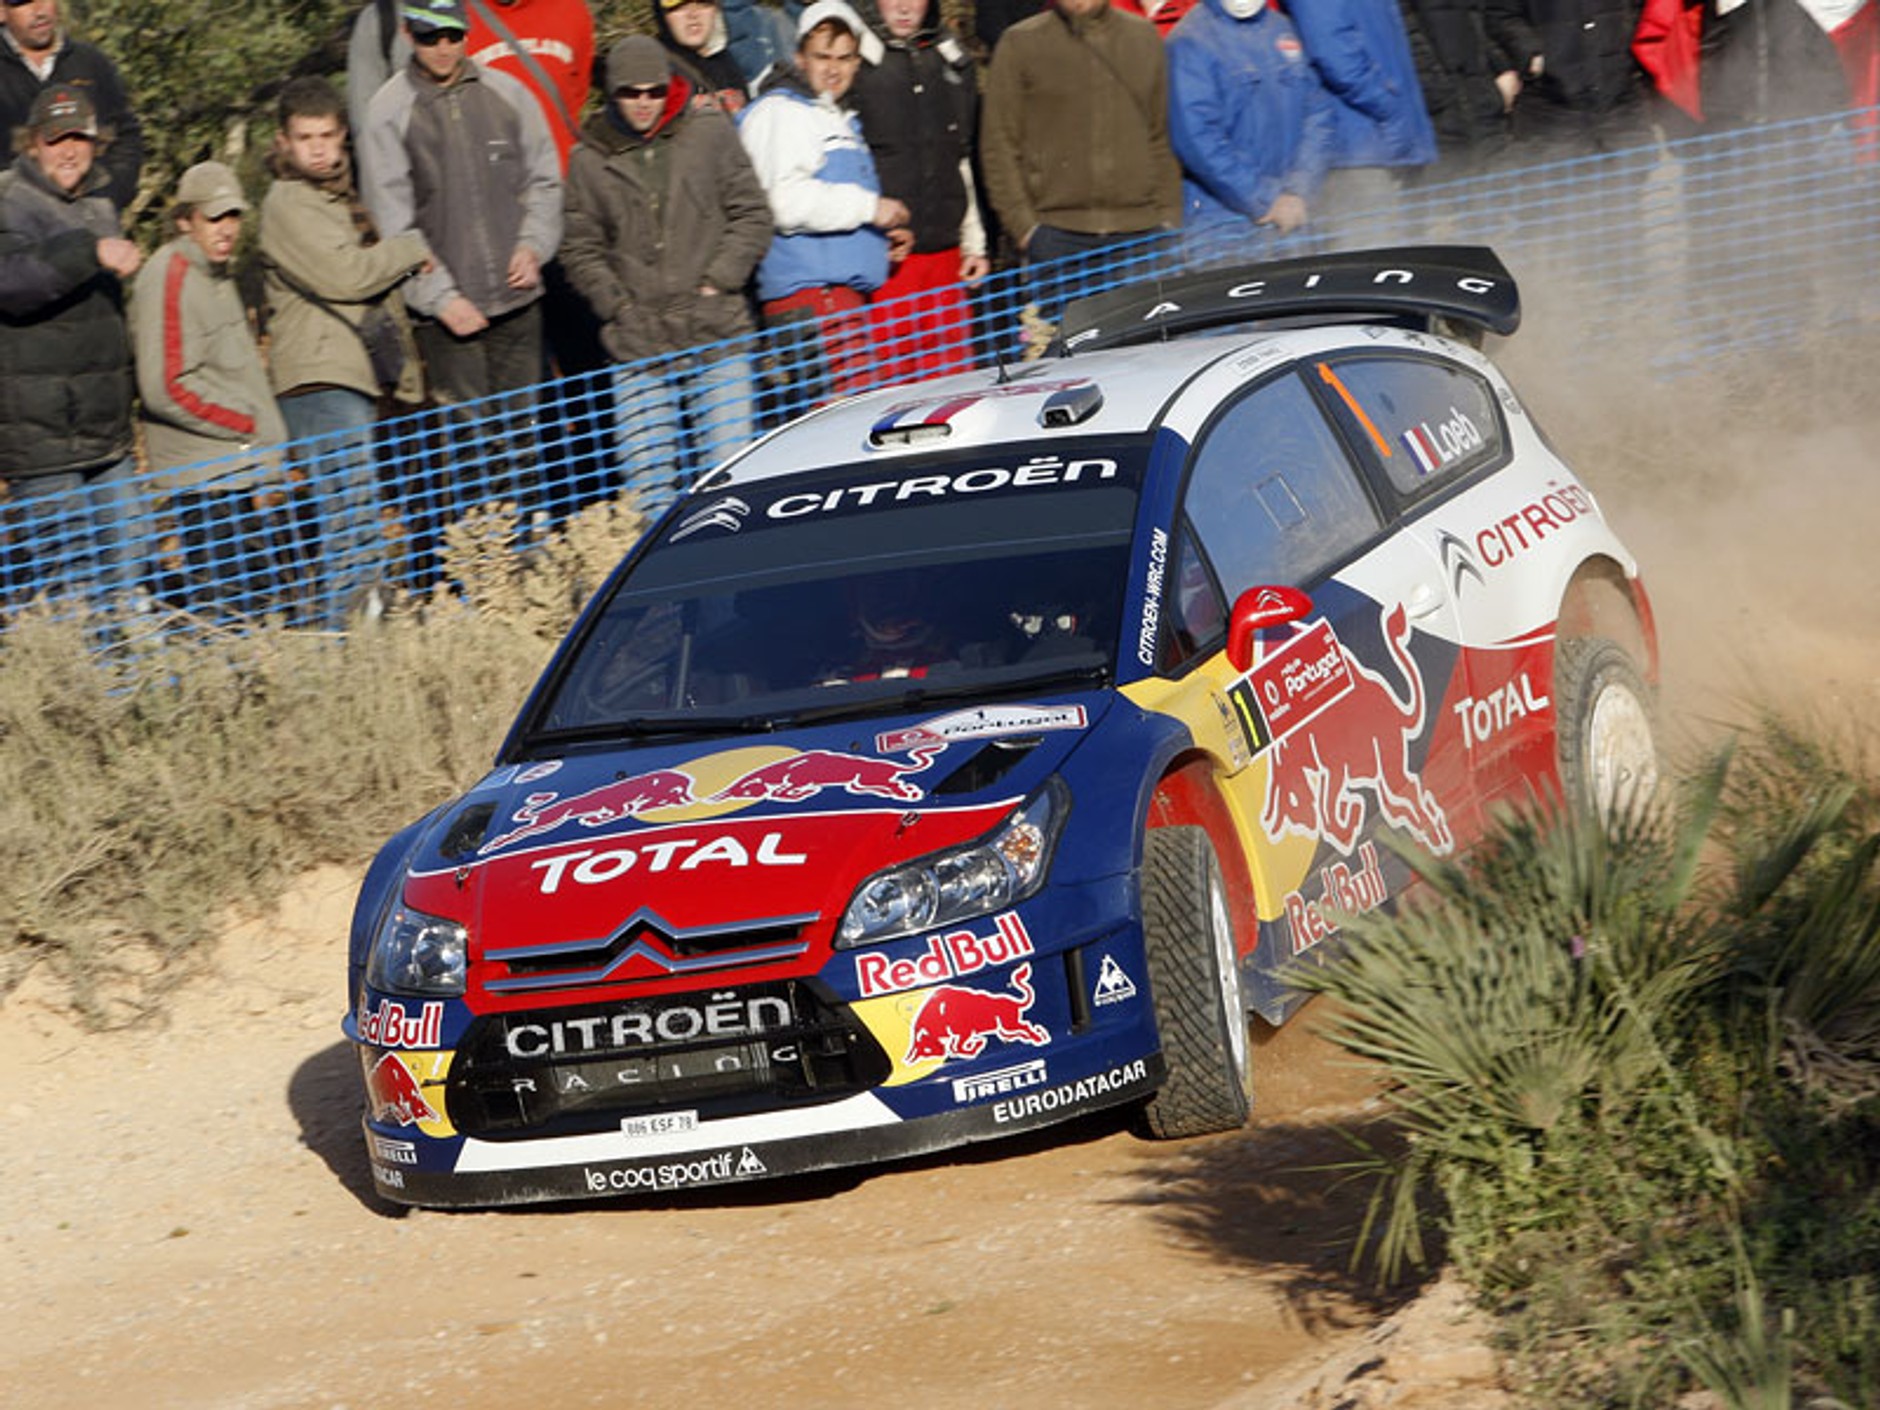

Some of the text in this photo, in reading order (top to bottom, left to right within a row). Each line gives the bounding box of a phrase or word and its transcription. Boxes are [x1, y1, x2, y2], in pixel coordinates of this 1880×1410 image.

[1421, 406, 1482, 463] Loeb
[1284, 645, 1341, 699] Portugal
[1233, 690, 1261, 748] 1
[1453, 672, 1550, 749] TOTAL
[530, 832, 808, 894] TOTAL
[1284, 840, 1387, 955] Red Bull
[855, 910, 1035, 997] Red Bull
[357, 1000, 444, 1048] ed Bull
[953, 1059, 1048, 1103] PIRELLI
[993, 1059, 1147, 1122] EURODATACAR
[584, 1151, 733, 1191] le coq sportif
